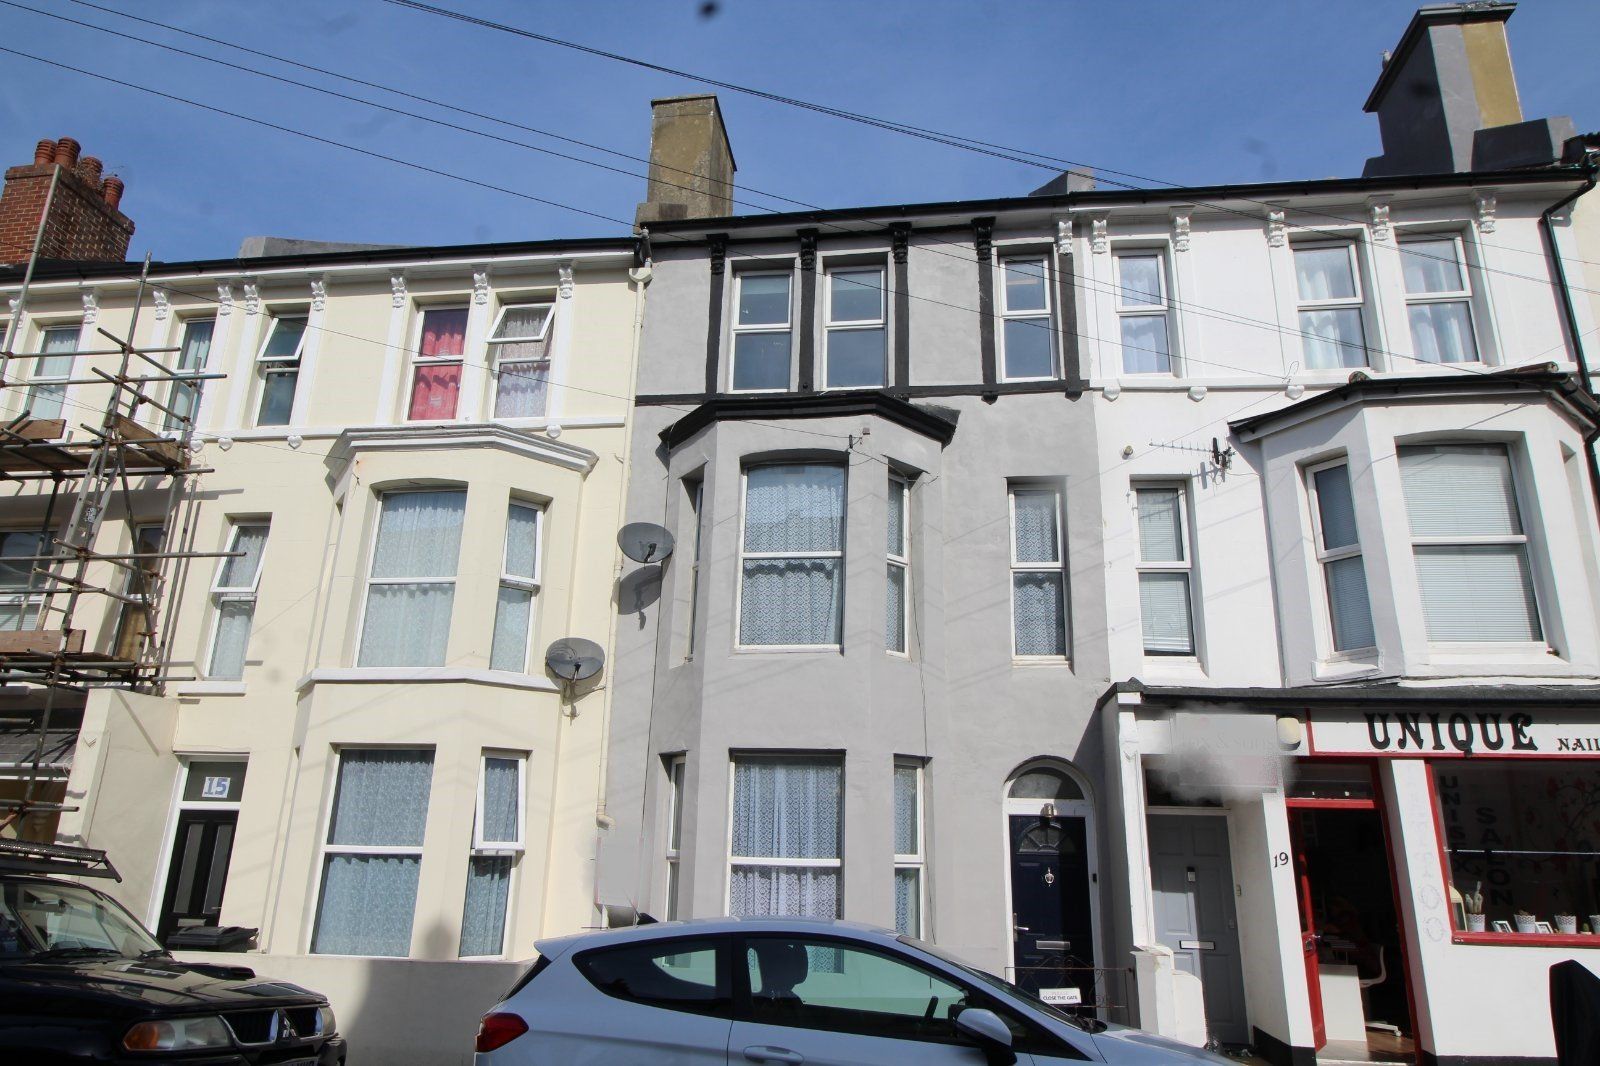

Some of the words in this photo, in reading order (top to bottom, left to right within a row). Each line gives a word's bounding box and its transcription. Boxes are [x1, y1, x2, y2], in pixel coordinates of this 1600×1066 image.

[1363, 712, 1538, 758] UNIQUE
[204, 777, 228, 796] 15
[1273, 851, 1289, 869] 19
